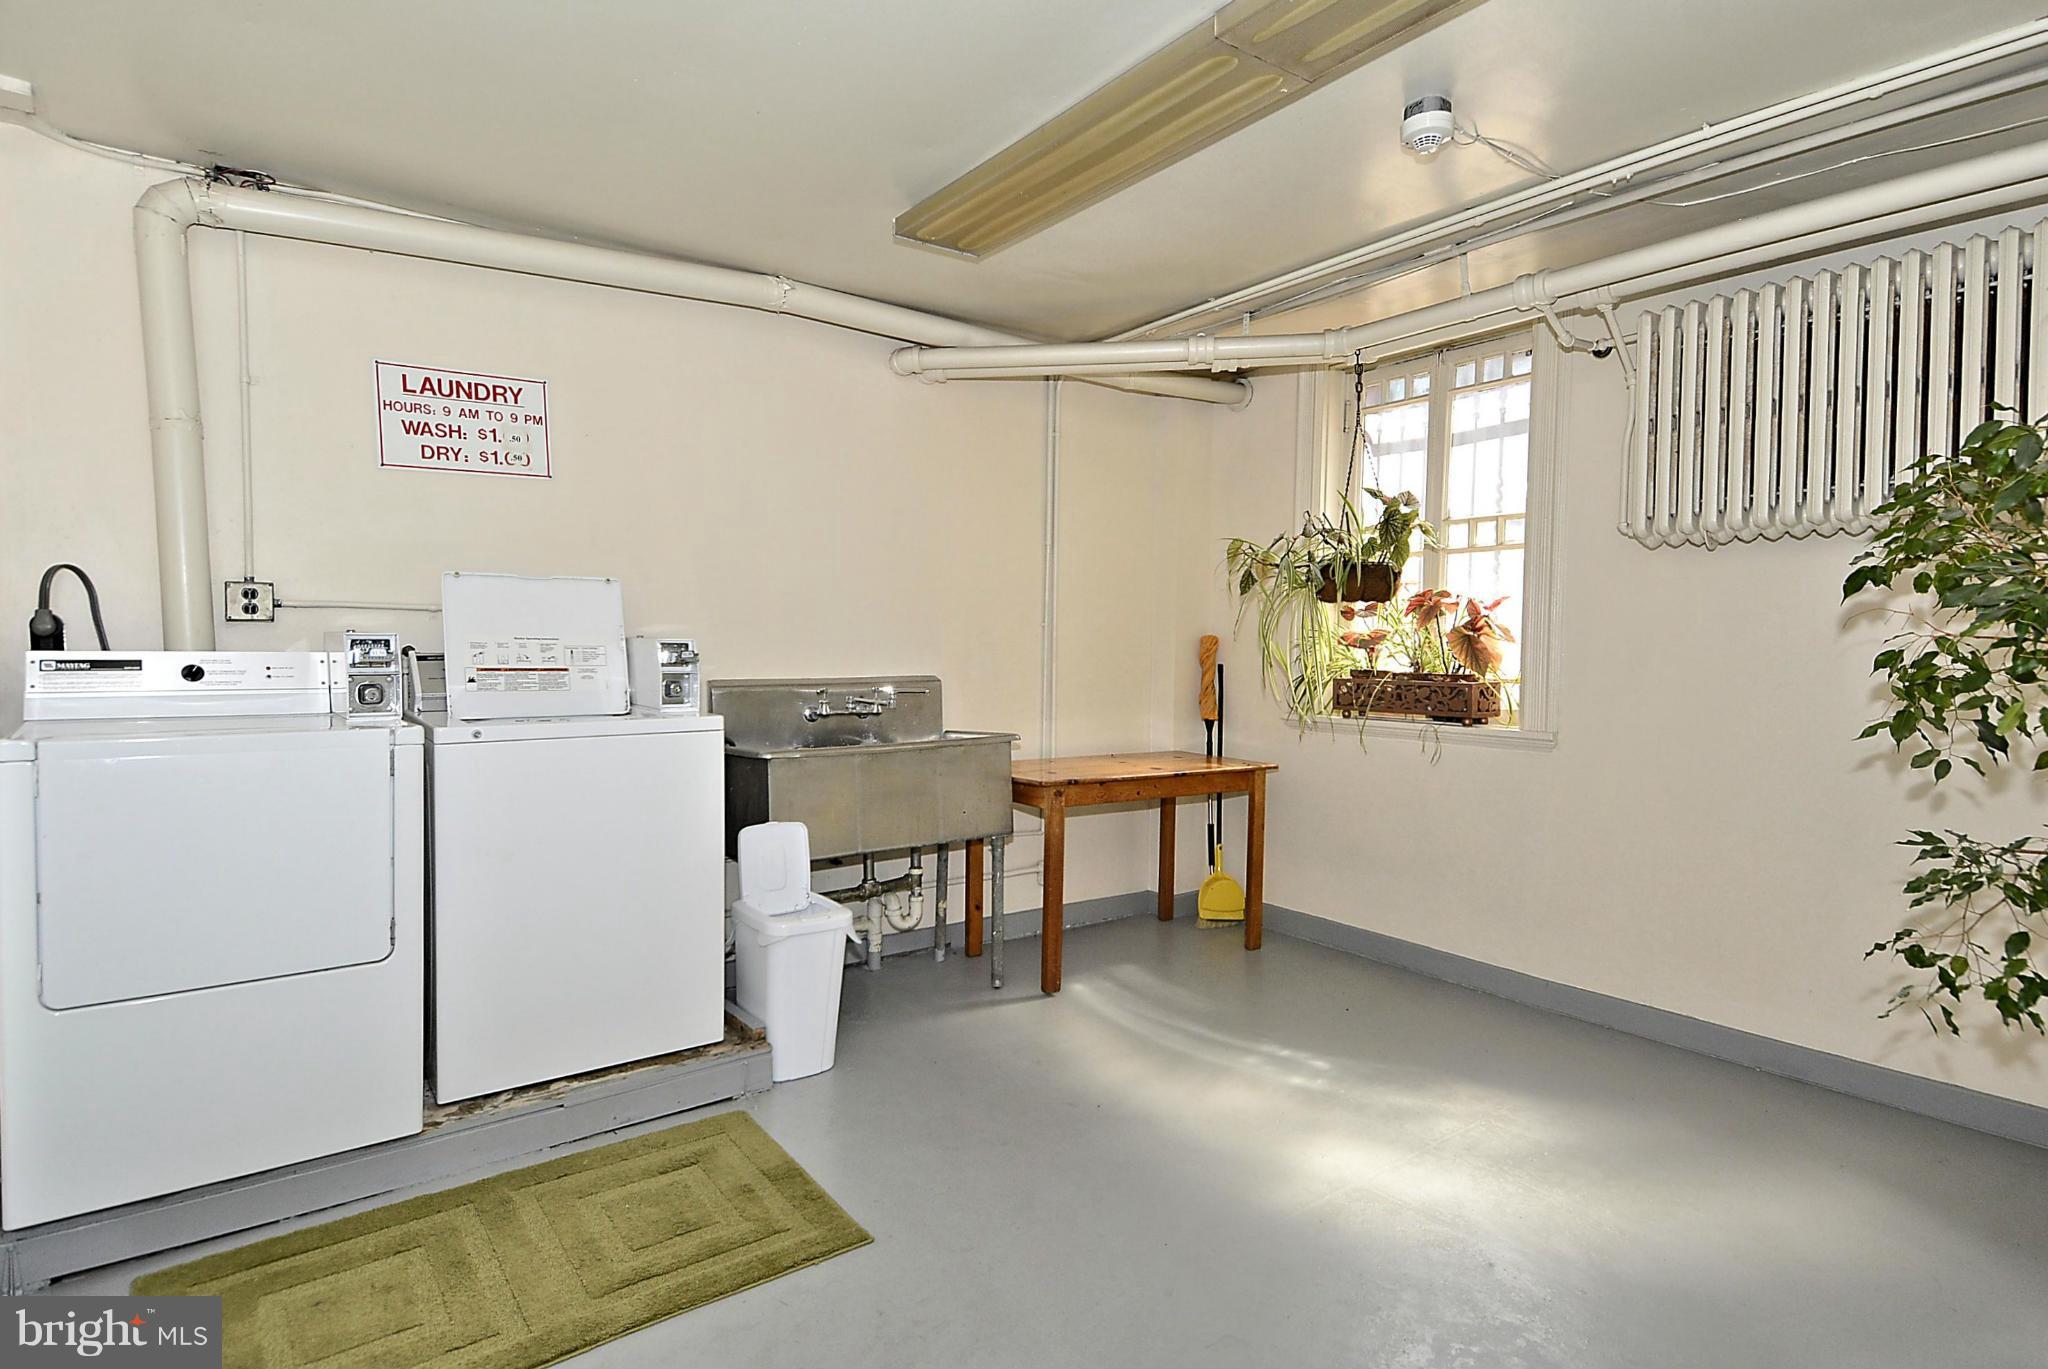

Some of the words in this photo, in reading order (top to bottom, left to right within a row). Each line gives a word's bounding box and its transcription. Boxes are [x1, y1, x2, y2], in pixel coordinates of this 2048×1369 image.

[401, 373, 523, 405] LAUNDRY
[383, 400, 436, 416] HOURS:
[442, 405, 451, 417] 9
[458, 408, 480, 420] AM
[486, 410, 504, 422] TO
[510, 413, 519, 423] 9
[524, 414, 544, 426] PM
[401, 419, 468, 440] WASH:
[420, 444, 469, 463] DRY:
